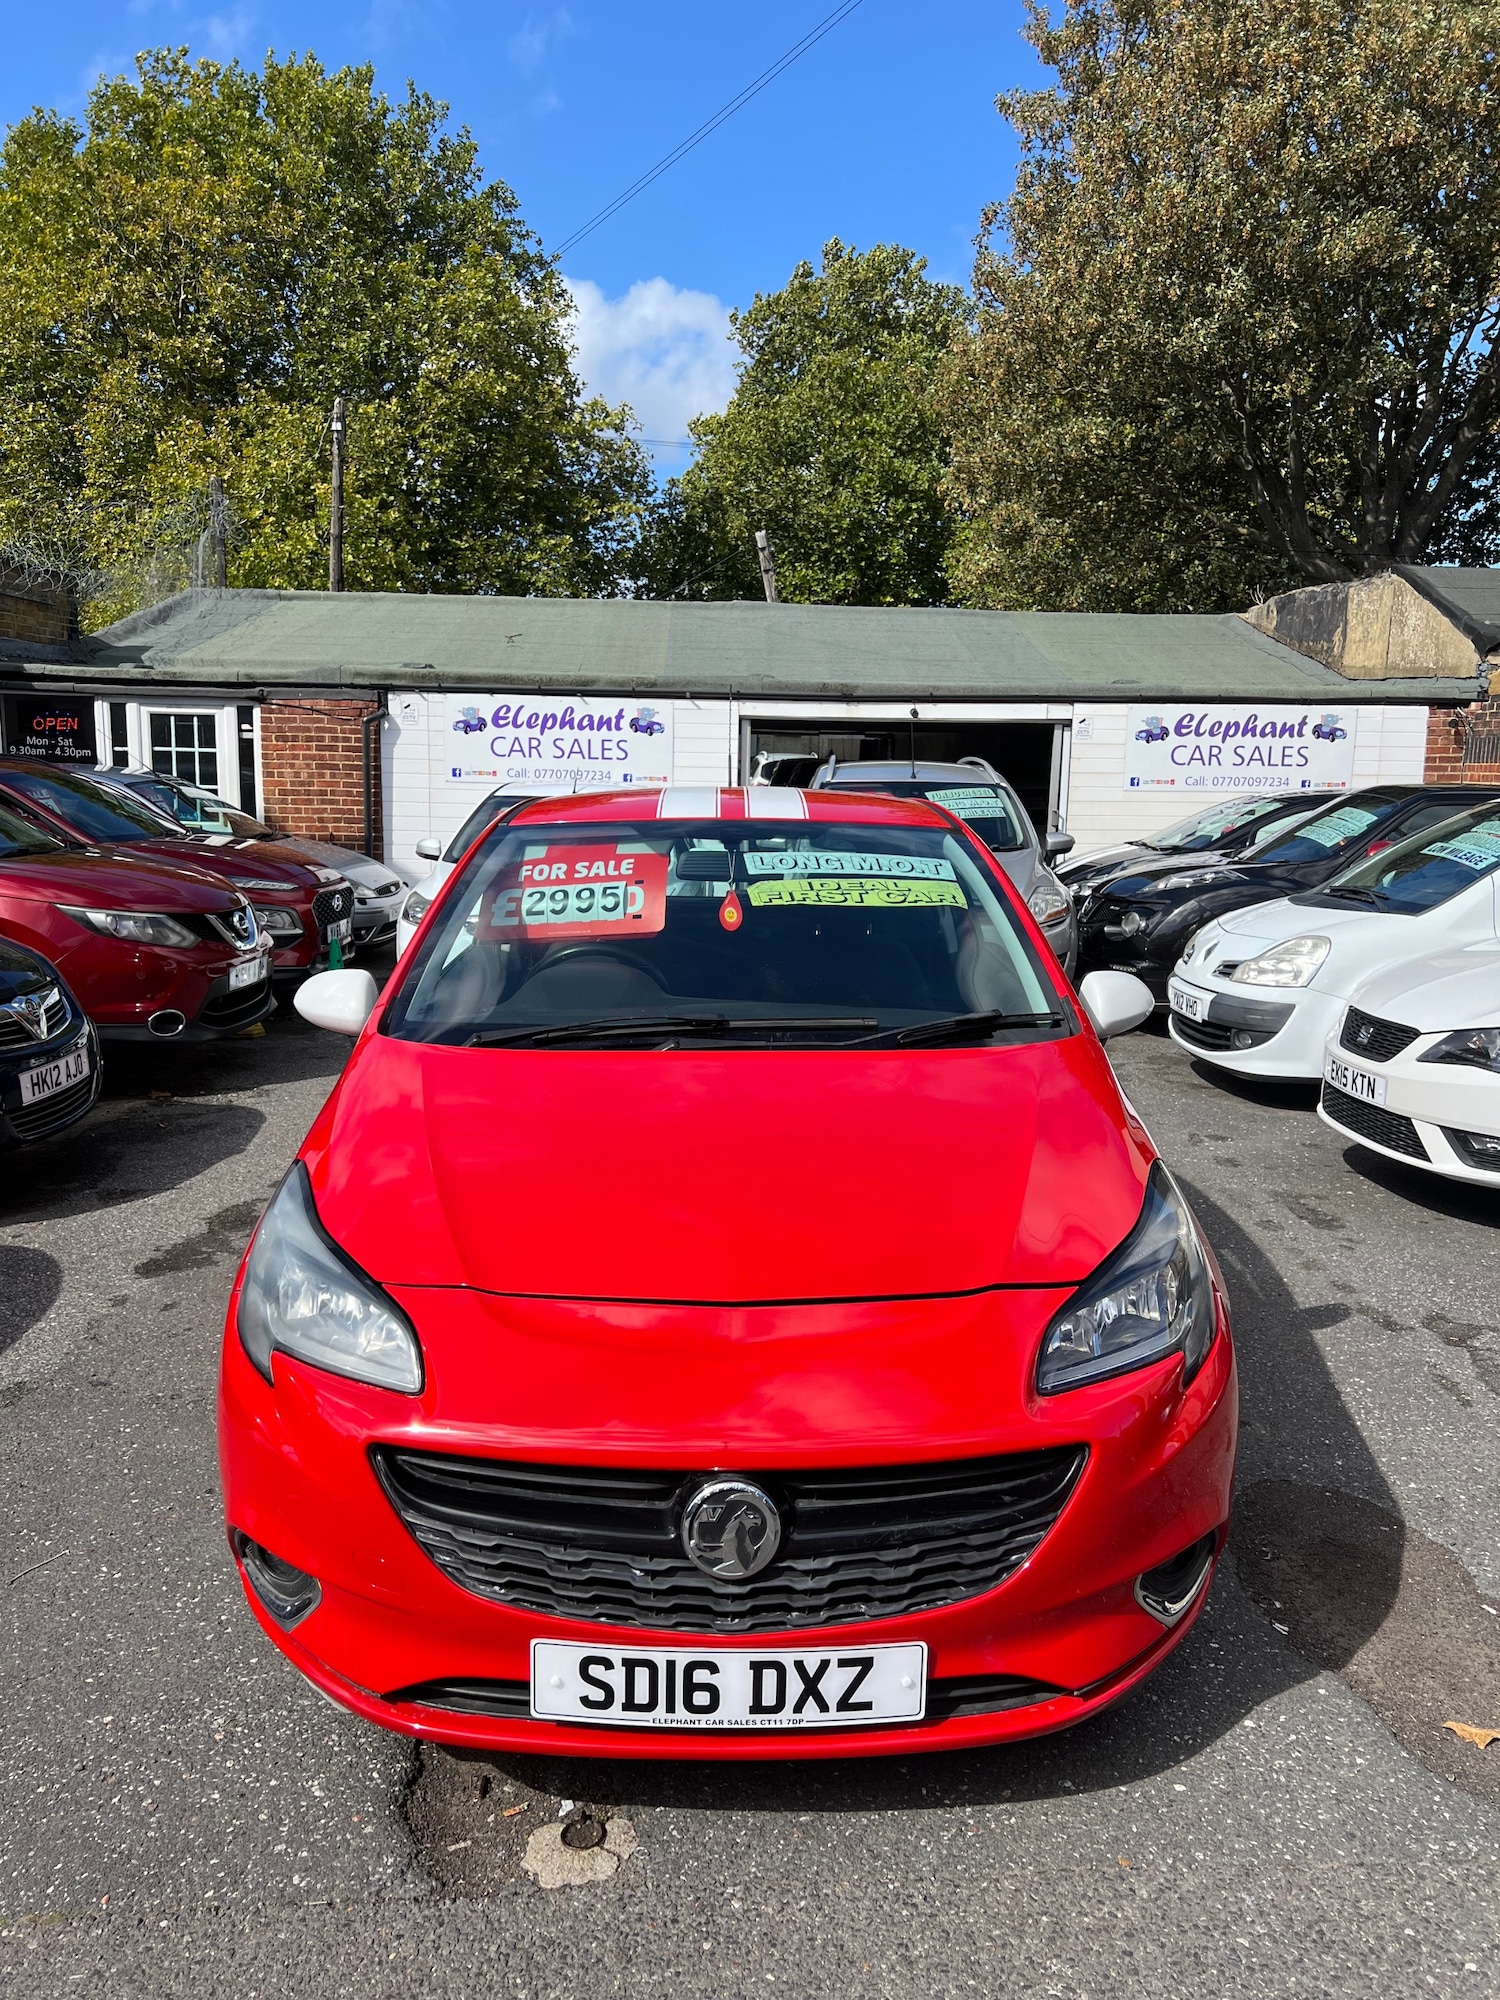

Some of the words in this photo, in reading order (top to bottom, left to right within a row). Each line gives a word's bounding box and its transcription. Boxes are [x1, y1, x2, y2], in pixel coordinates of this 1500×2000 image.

[33, 717, 79, 730] OPEN
[491, 704, 625, 735] Elephant
[1173, 713, 1309, 744] Elephant
[26, 736, 49, 746] Mon
[57, 736, 73, 747] Sat
[490, 736, 542, 759] CAR
[552, 738, 629, 761] SALES
[9, 745, 46, 756] 9.30am
[54, 746, 92, 758] 4.30pm
[1171, 745, 1222, 766] CAR
[1232, 745, 1310, 767] SALES
[506, 768, 530, 779] Call:
[534, 769, 612, 781] 07707097234
[1184, 776, 1208, 787] Call:
[1212, 776, 1290, 788] 07707097234
[752, 854, 845, 870] LONG
[1427, 843, 1452, 854] LOW
[1444, 847, 1489, 866] MILEAGE
[518, 863, 568, 882] FOR
[573, 858, 635, 879] SALE
[799, 879, 912, 892] IDEAL
[758, 890, 865, 905] FIRST
[878, 890, 960, 905] CAR
[30, 1065, 62, 1097] HK12
[66, 1053, 83, 1083] AJO
[1331, 1059, 1348, 1087] EK15
[1351, 1070, 1376, 1099] KTN
[578, 1655, 721, 1716] SD16
[748, 1656, 875, 1716] DXZ
[652, 1717, 702, 1726] ELEPHANT
